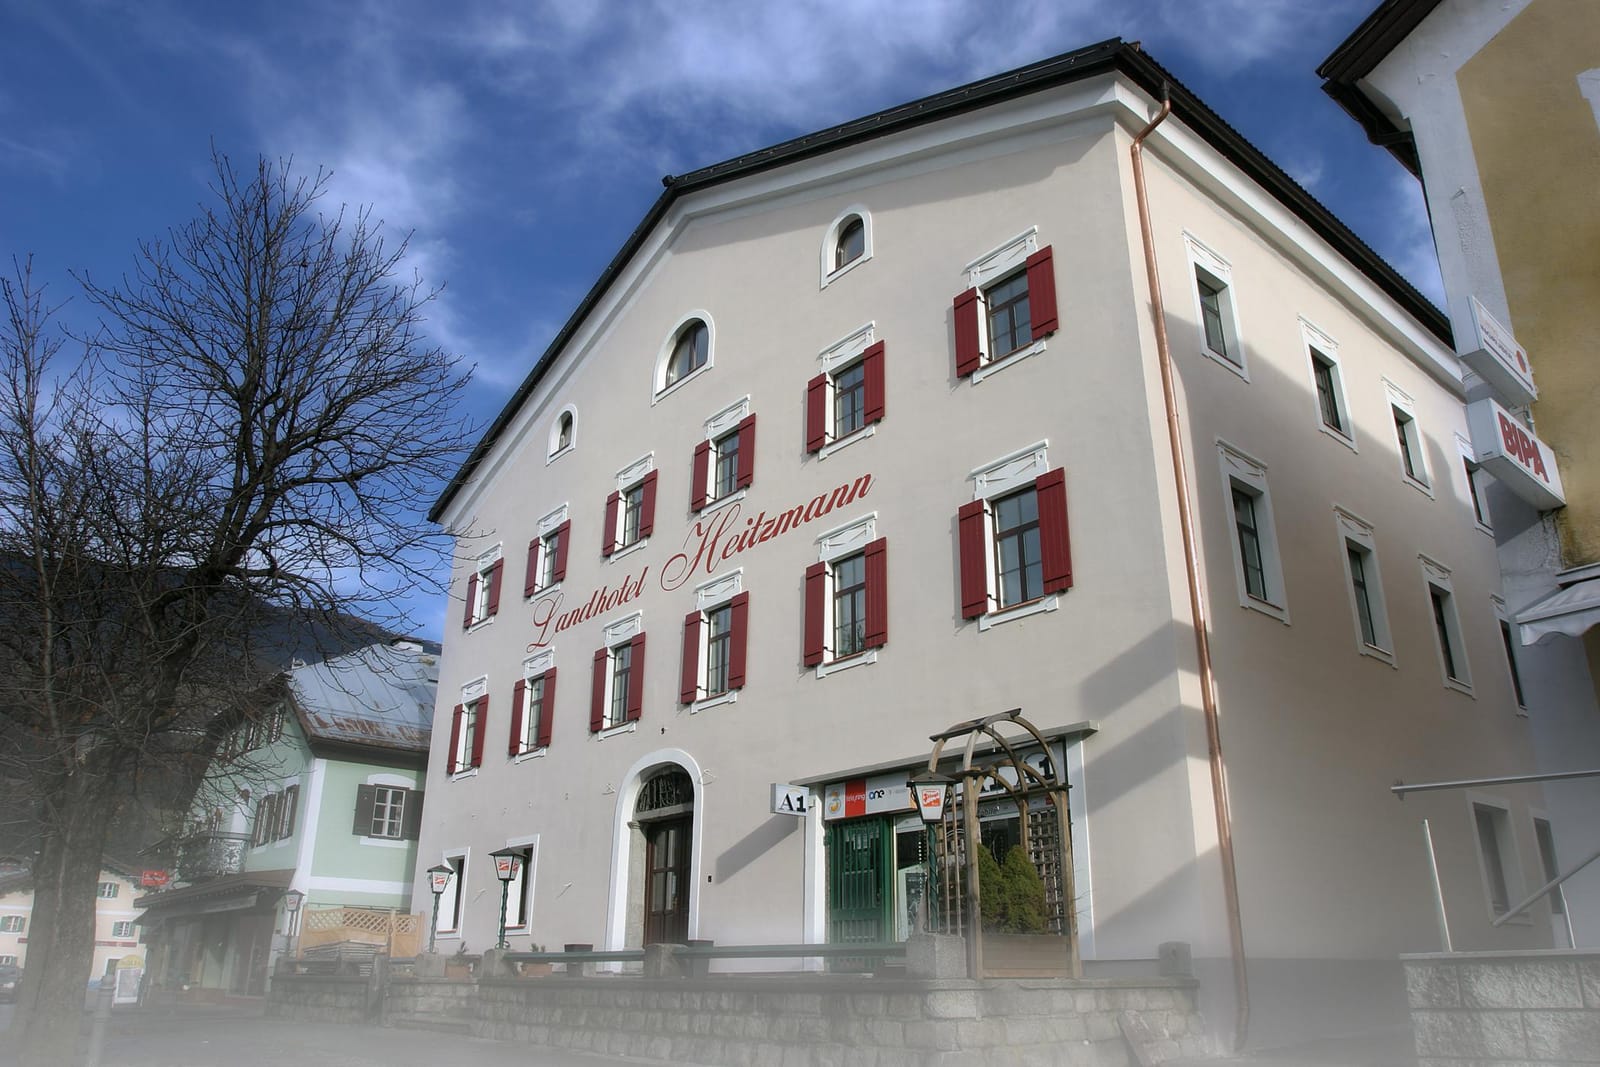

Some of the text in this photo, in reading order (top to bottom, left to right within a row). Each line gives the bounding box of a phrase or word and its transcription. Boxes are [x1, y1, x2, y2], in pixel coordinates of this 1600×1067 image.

[1498, 411, 1550, 484] BIPA
[526, 473, 875, 653] Landhotel Heitzmann
[779, 793, 807, 813] A1
